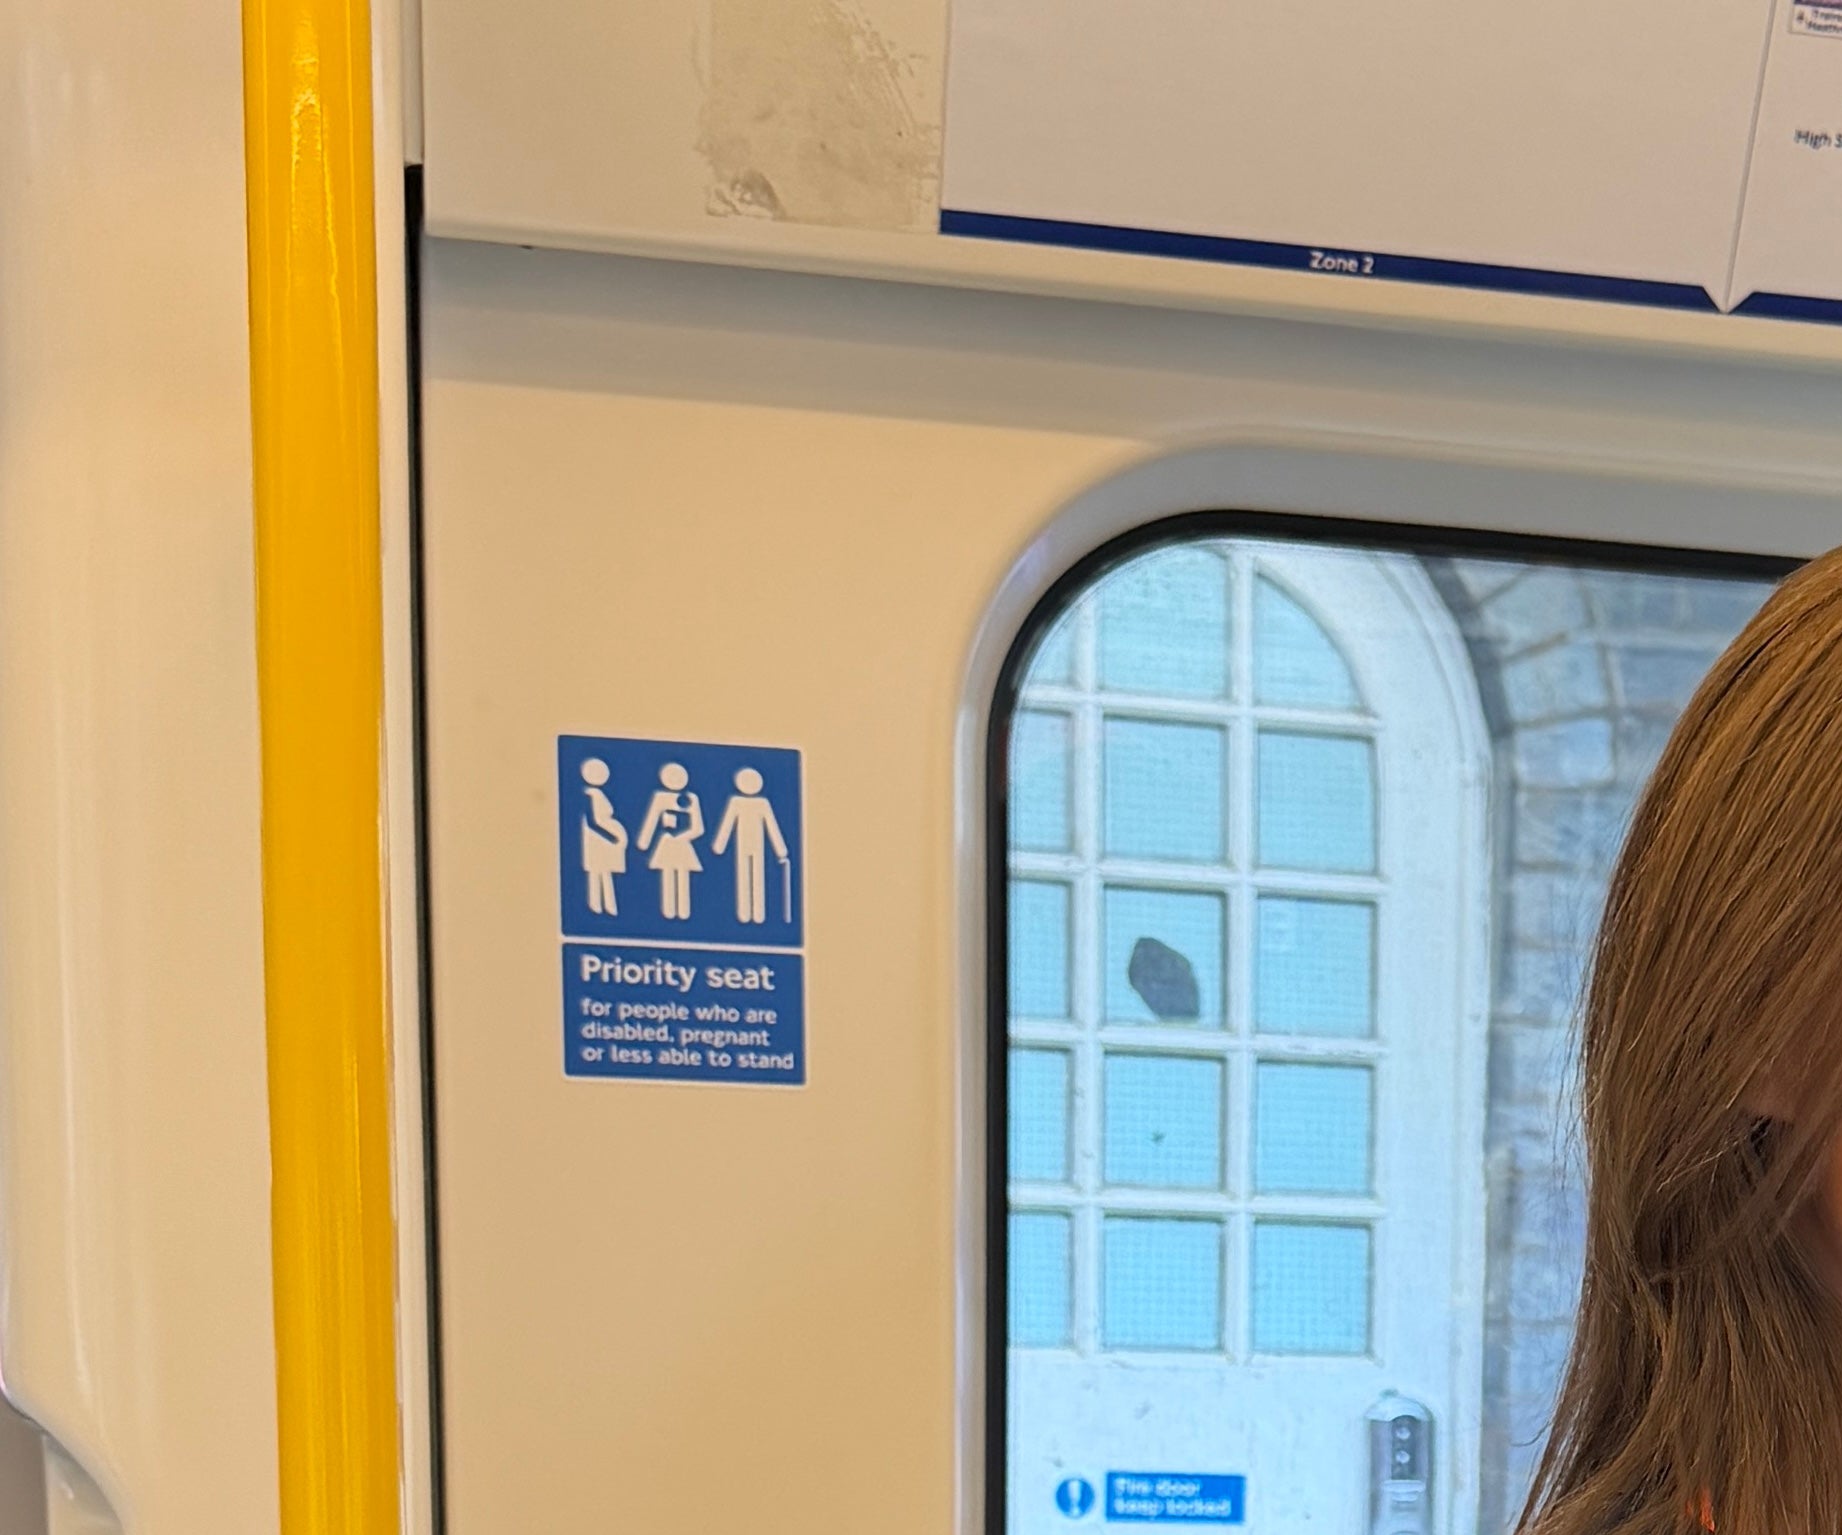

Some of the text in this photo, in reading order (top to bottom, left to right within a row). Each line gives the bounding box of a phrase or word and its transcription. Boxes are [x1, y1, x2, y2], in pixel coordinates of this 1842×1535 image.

[1794, 128, 1831, 149] High
[1309, 250, 1374, 274] Zone 2
[579, 953, 776, 992] Priority seat
[580, 997, 778, 1028] for people who are
[679, 1027, 771, 1050] pregnant
[580, 1045, 795, 1071] or less able to stand
